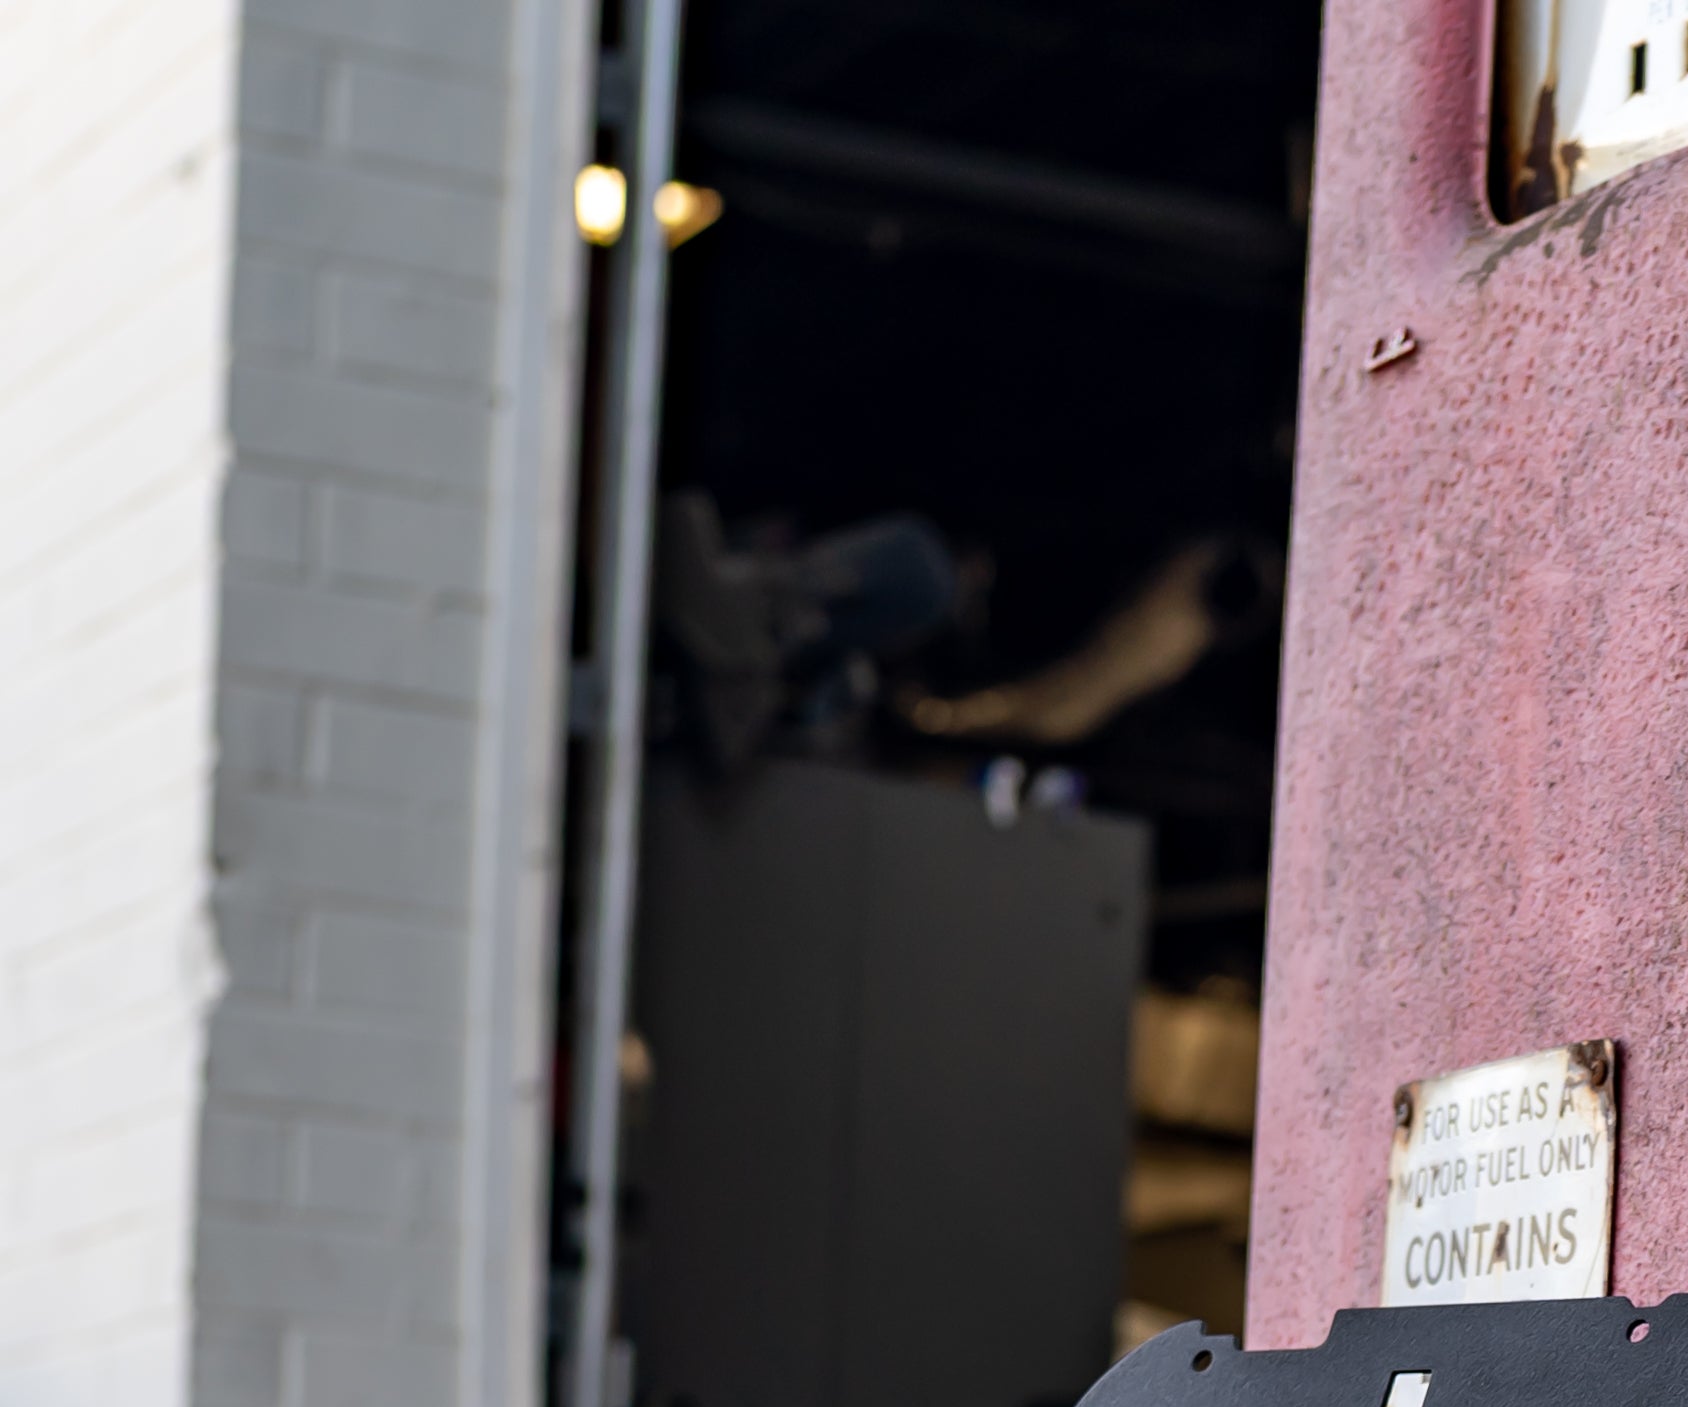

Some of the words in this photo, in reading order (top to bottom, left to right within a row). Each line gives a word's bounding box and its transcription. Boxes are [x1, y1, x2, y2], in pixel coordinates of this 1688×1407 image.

[1422, 1103, 1460, 1144] FOR
[1469, 1090, 1511, 1133] USE
[1516, 1082, 1549, 1122] AS
[1559, 1082, 1575, 1118] A
[1398, 1157, 1467, 1204] MOTOR
[1475, 1145, 1530, 1188] FUEL
[1539, 1131, 1601, 1177] ONLY
[1405, 1207, 1578, 1289] CONTAINS
